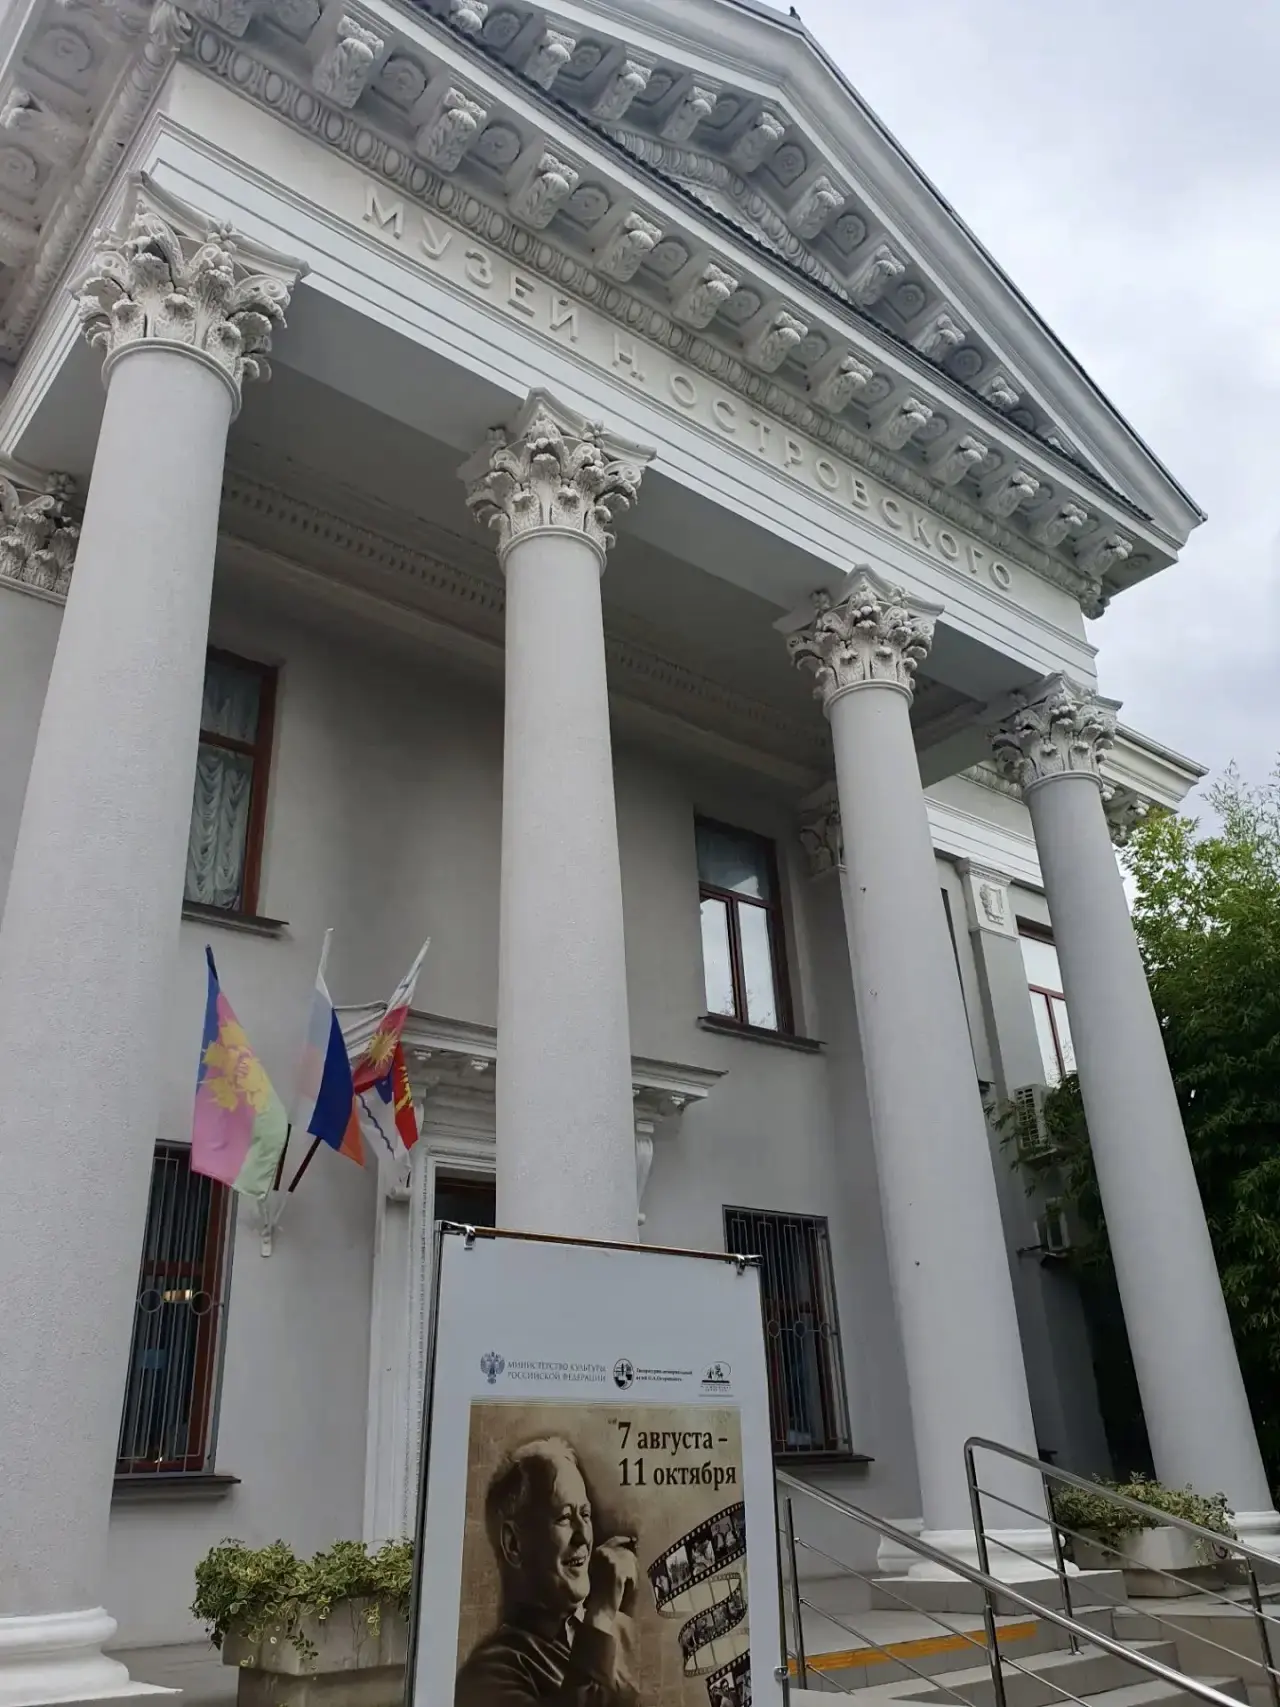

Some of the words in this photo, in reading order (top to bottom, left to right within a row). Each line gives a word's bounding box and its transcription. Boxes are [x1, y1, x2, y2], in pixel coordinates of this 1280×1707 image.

[362, 185, 578, 343] МУЗЕЙ
[669, 370, 1013, 591] ОСТРОВСКОГО
[506, 1360, 569, 1371] МИНИСТЕРСТВО
[570, 1362, 606, 1373] КУЛЬТУРЫ
[618, 1421, 631, 1449] 7
[637, 1431, 713, 1456] августа
[618, 1457, 647, 1486] 11
[653, 1460, 736, 1491] октября
